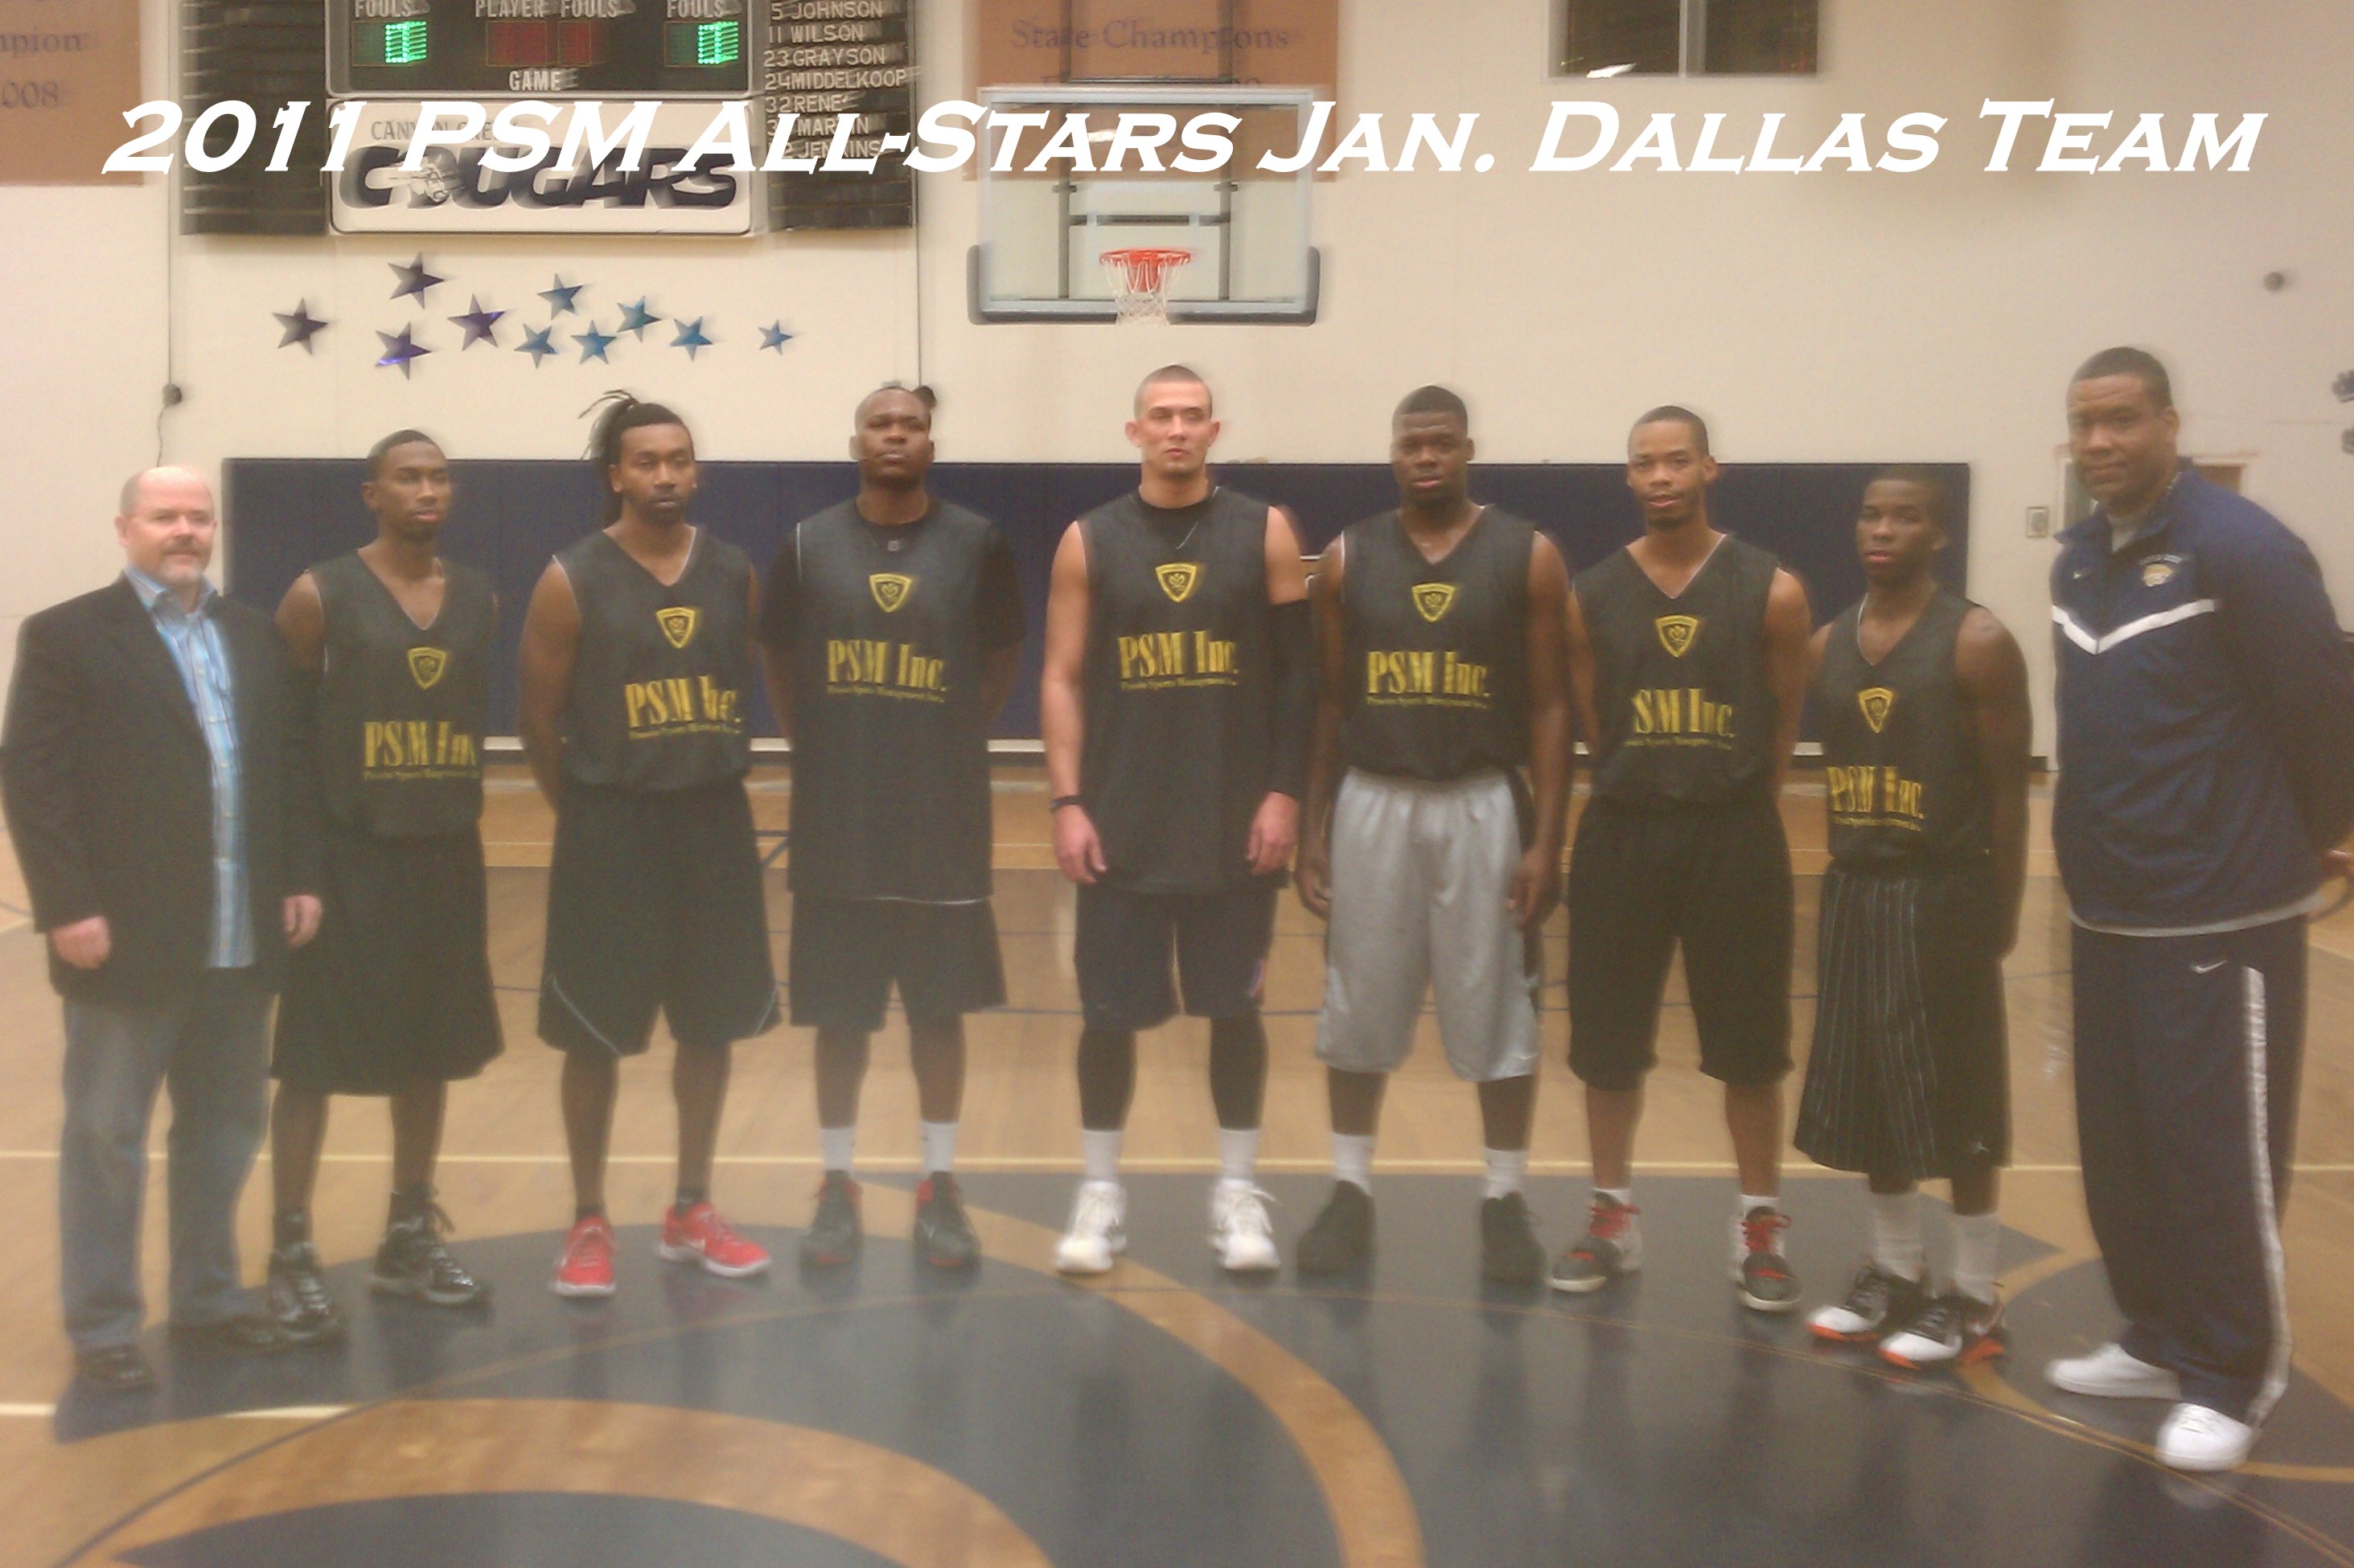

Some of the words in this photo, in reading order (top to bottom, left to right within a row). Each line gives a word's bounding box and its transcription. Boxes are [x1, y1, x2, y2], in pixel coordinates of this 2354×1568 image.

[355, 0, 411, 18] FOULS
[475, 0, 544, 18] PLAYER
[561, 0, 618, 18] FOULS
[667, 0, 723, 18] FOULS
[771, 2, 783, 20] 5
[791, 1, 884, 19] JOHNSON
[791, 23, 864, 43] WILSON
[763, 49, 790, 68] 23
[791, 47, 885, 67] GRAYSON
[508, 70, 562, 91] GAME
[765, 72, 791, 91] 24
[791, 69, 907, 90] MIDDELKOOP
[765, 96, 792, 113] 32
[372, 121, 448, 140] CANYN
[797, 117, 869, 136] MARIN
[828, 639, 888, 683] PSM
[1117, 630, 1184, 679] PSM
[1368, 651, 1435, 695] PSM
[624, 678, 694, 729] PSM
[1633, 689, 1681, 733] SM
[364, 720, 428, 768] PSM
